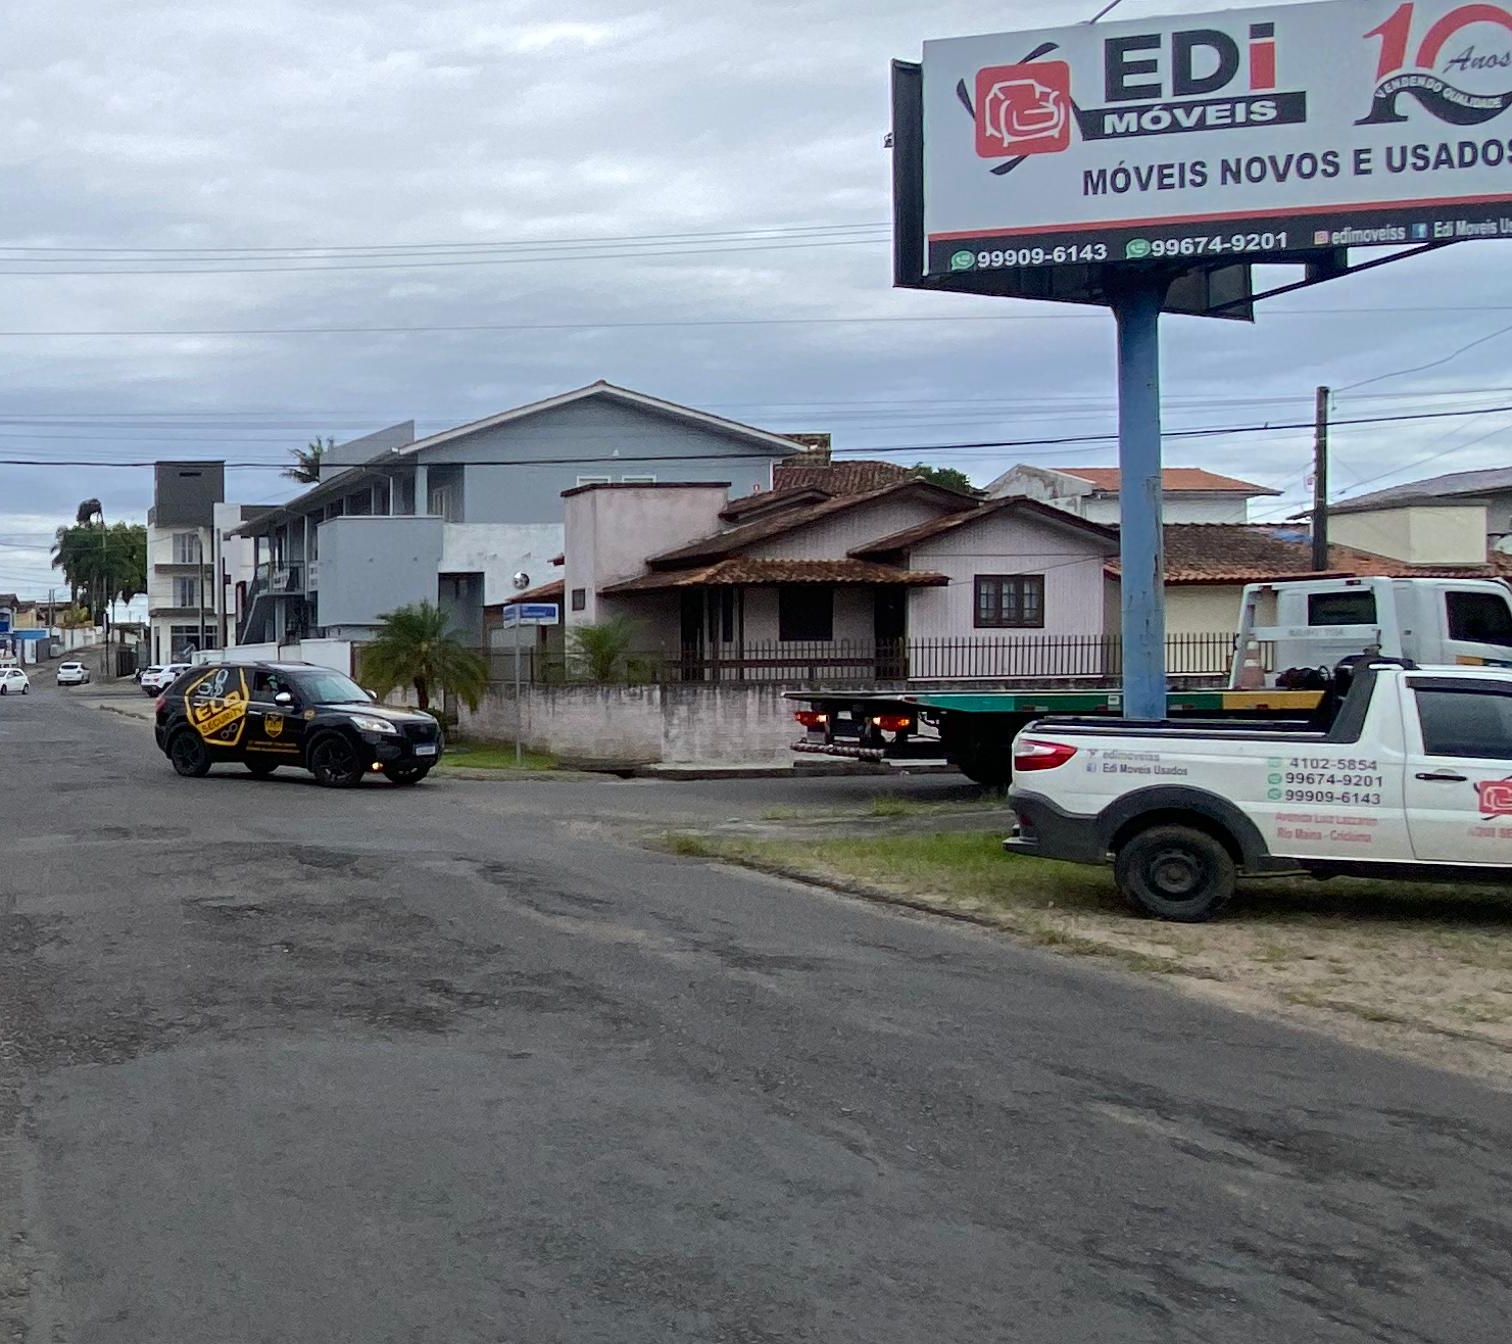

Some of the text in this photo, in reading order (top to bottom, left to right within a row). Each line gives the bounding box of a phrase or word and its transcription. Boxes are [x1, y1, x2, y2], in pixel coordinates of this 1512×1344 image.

[1442, 45, 1512, 73] Anos
[1104, 100, 1277, 135] MÓVEIS
[1083, 160, 1208, 196] MÓVEIS
[1220, 150, 1341, 185] NOVOS
[1353, 148, 1372, 176] E
[977, 231, 1288, 268] 99909-6143 99674-9201
[201, 703, 245, 733] SECURITY
[1285, 772, 1383, 787] 99674-9201
[1285, 789, 1381, 805] 99909-6143
